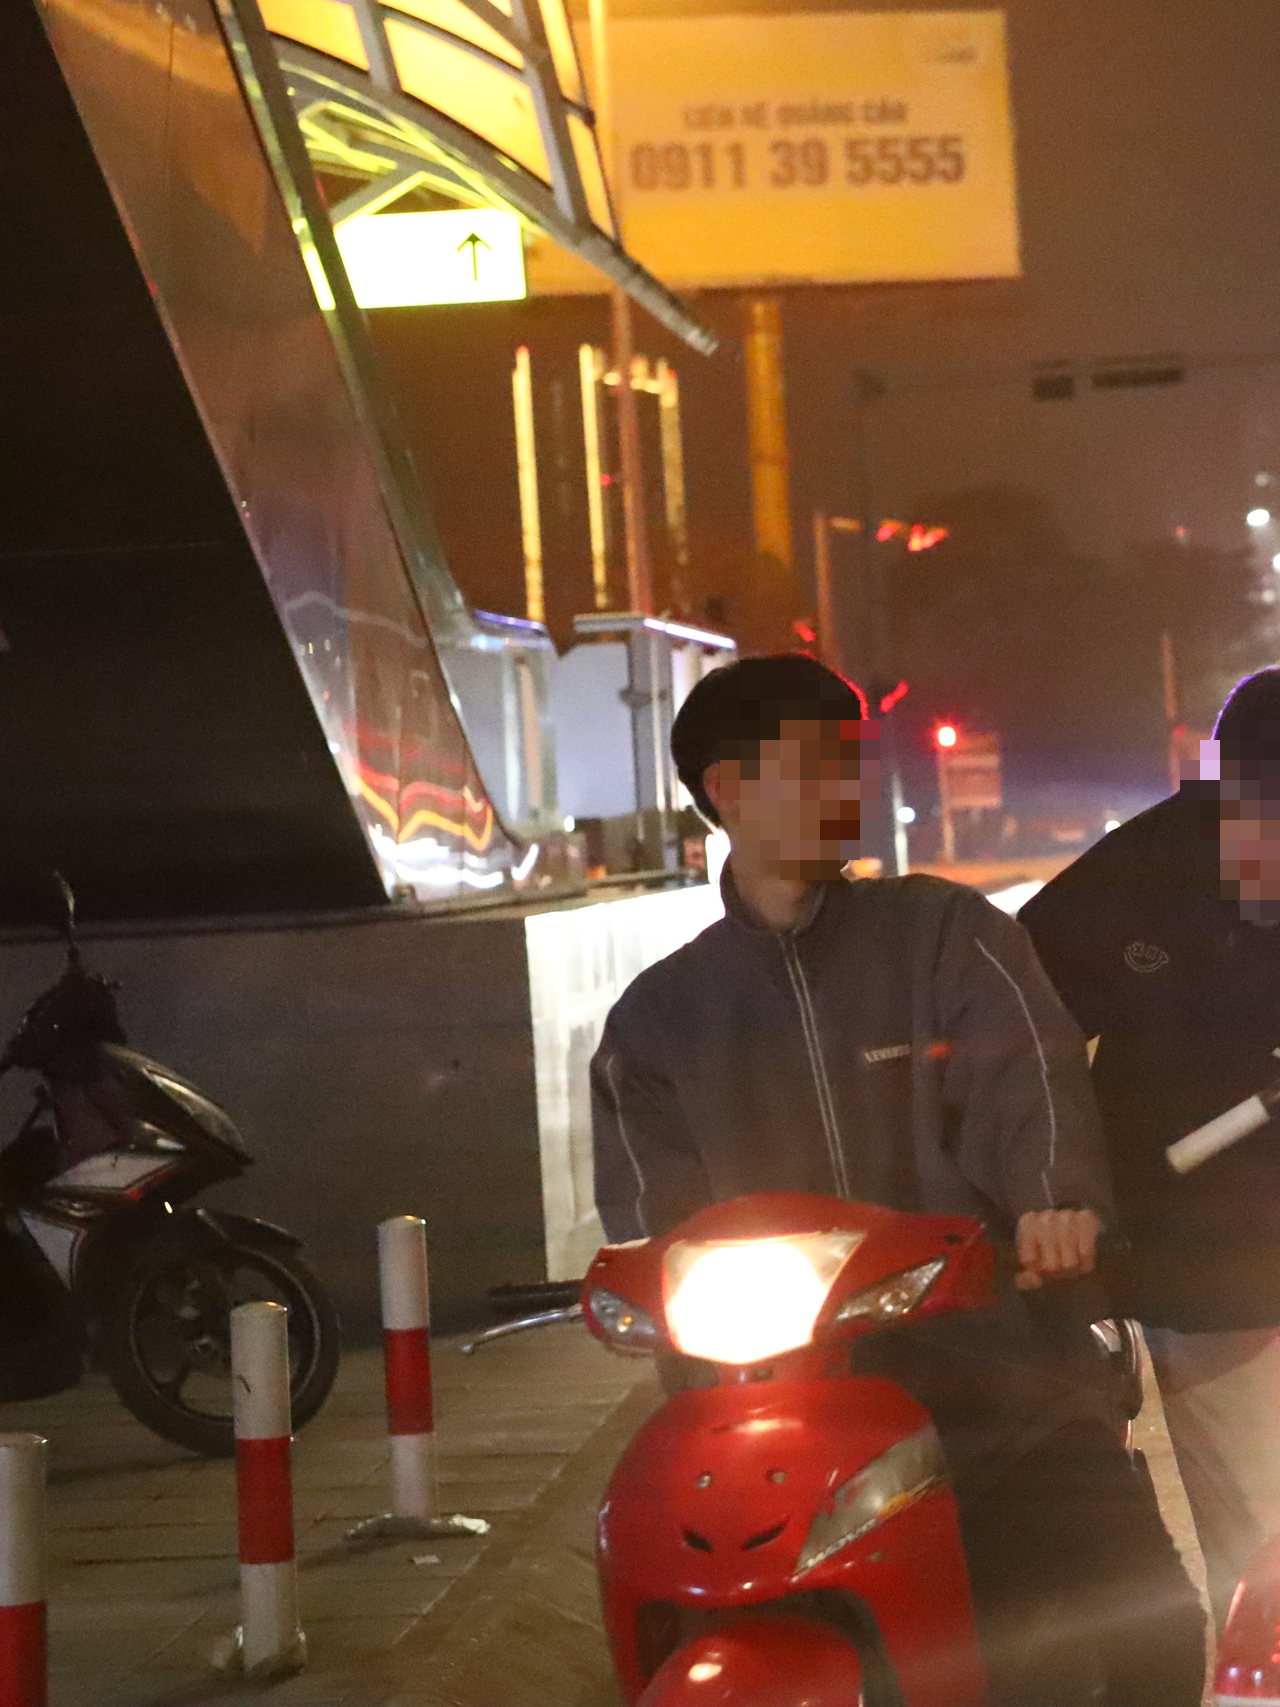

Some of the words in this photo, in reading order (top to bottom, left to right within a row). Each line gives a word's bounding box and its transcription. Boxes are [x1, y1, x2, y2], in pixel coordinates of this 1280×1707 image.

[629, 141, 748, 191] 0911
[768, 137, 830, 189] 39
[844, 134, 967, 186] 5555
